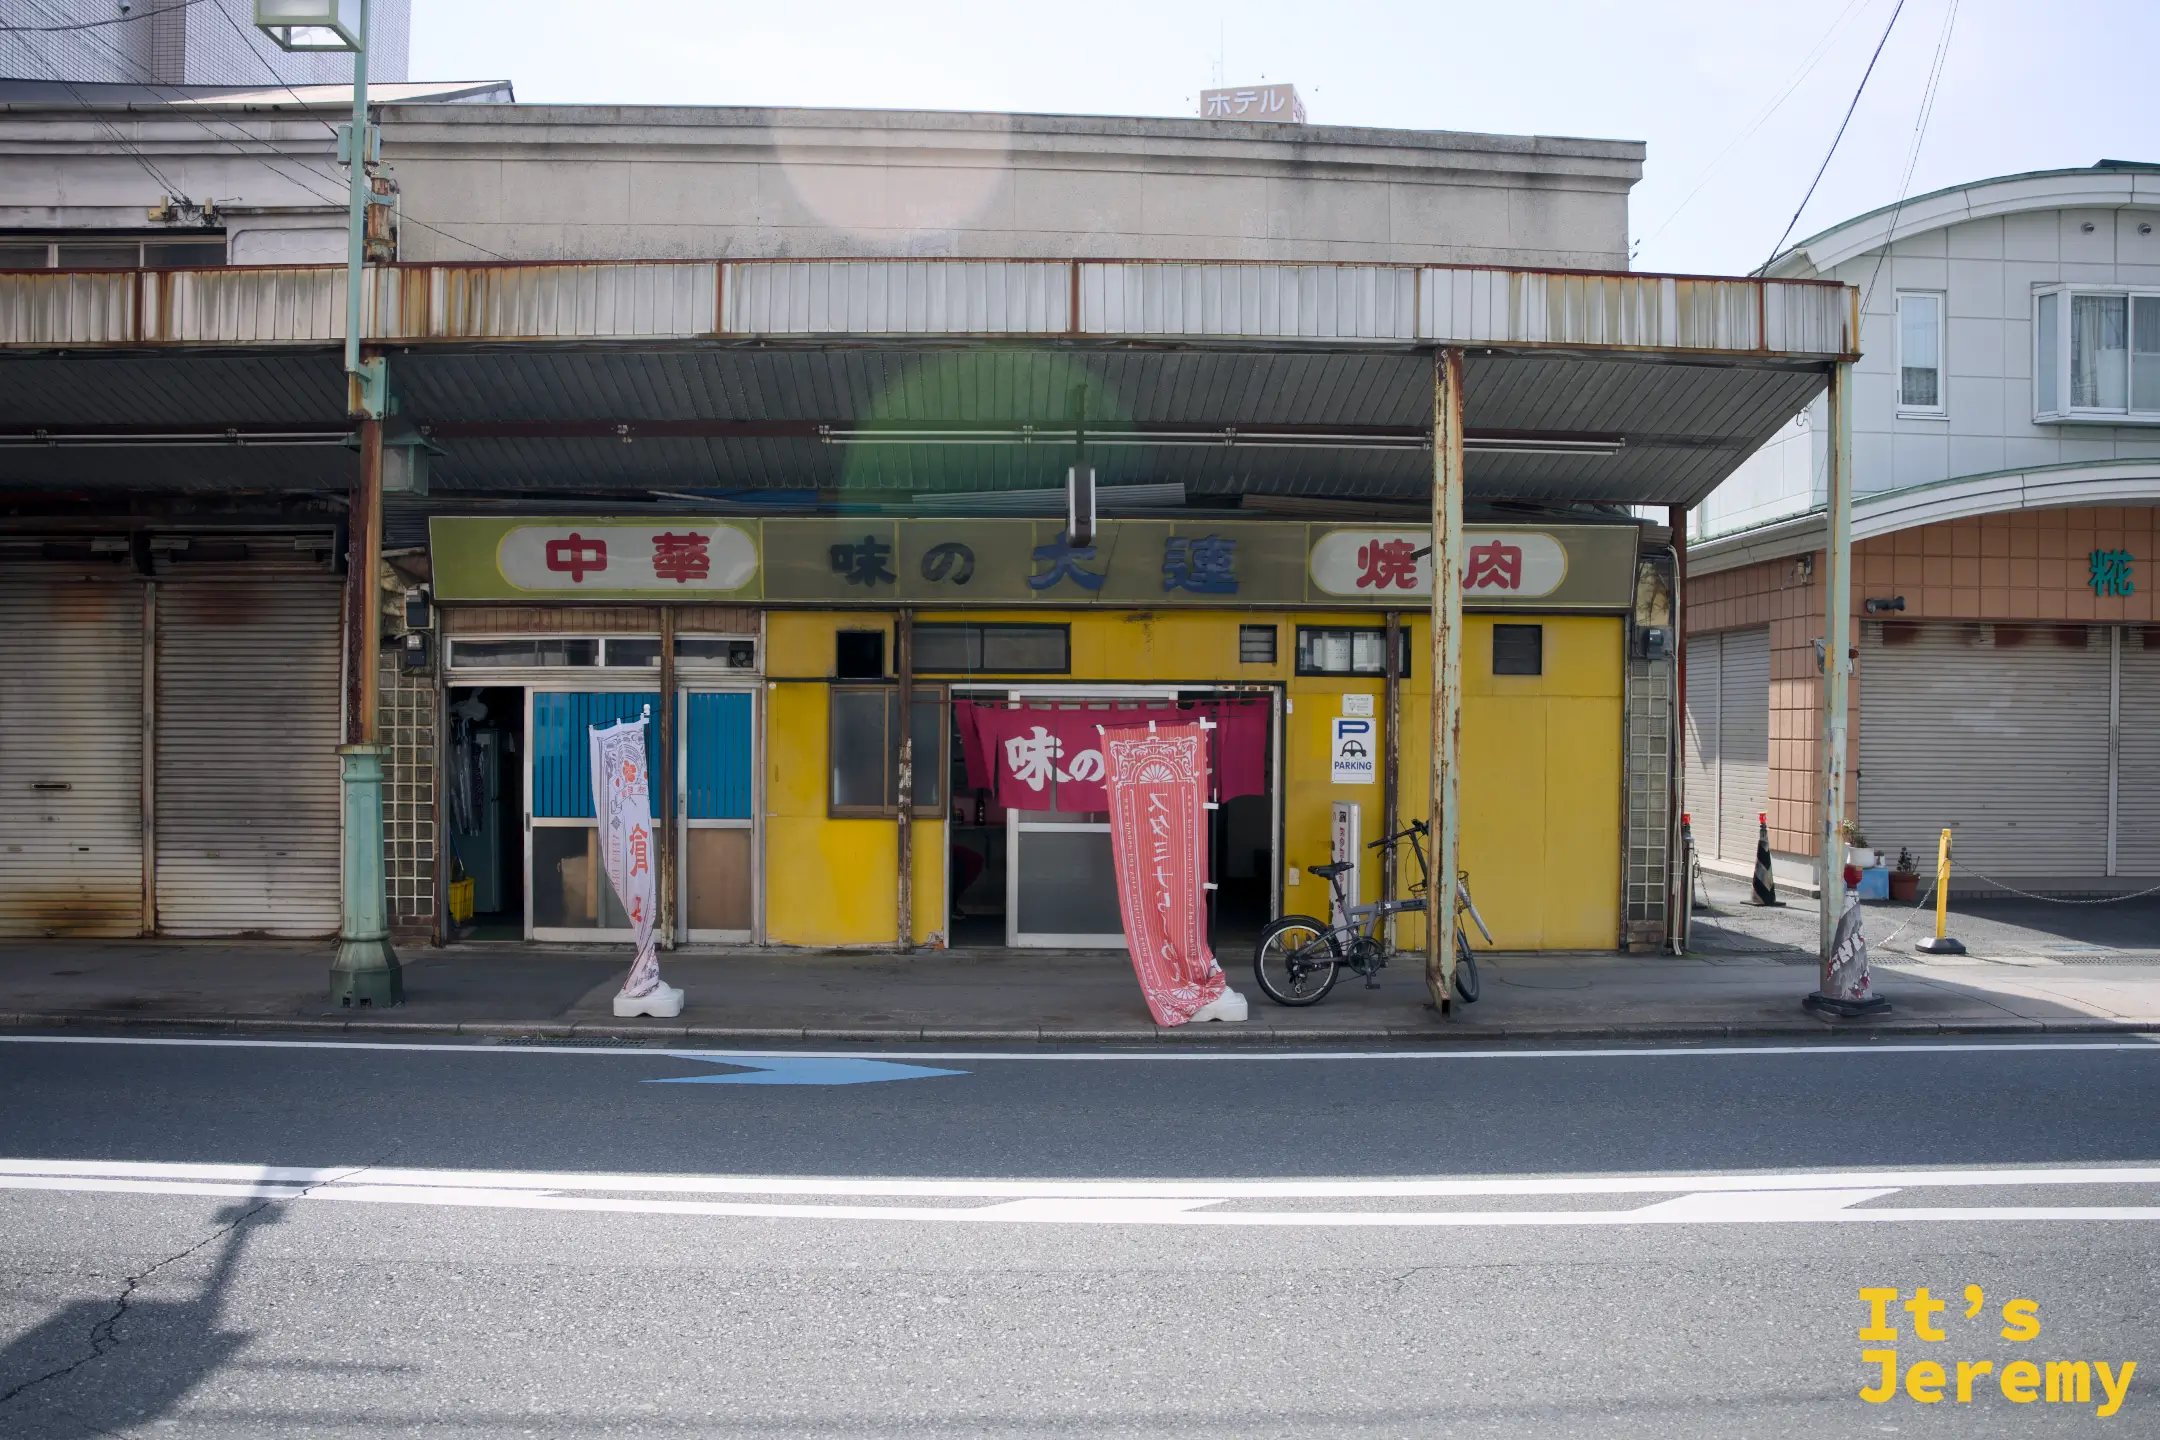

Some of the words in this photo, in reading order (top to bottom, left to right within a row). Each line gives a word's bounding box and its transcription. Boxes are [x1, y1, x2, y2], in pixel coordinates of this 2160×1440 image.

[1207, 88, 1285, 117] ホテル
[545, 531, 711, 583] 中華
[830, 531, 1240, 594] 味の大連
[1356, 539, 1522, 589] 焼肉
[2089, 548, 2135, 597] 糀
[1338, 720, 1370, 740] P
[1334, 761, 1372, 770] PARKING
